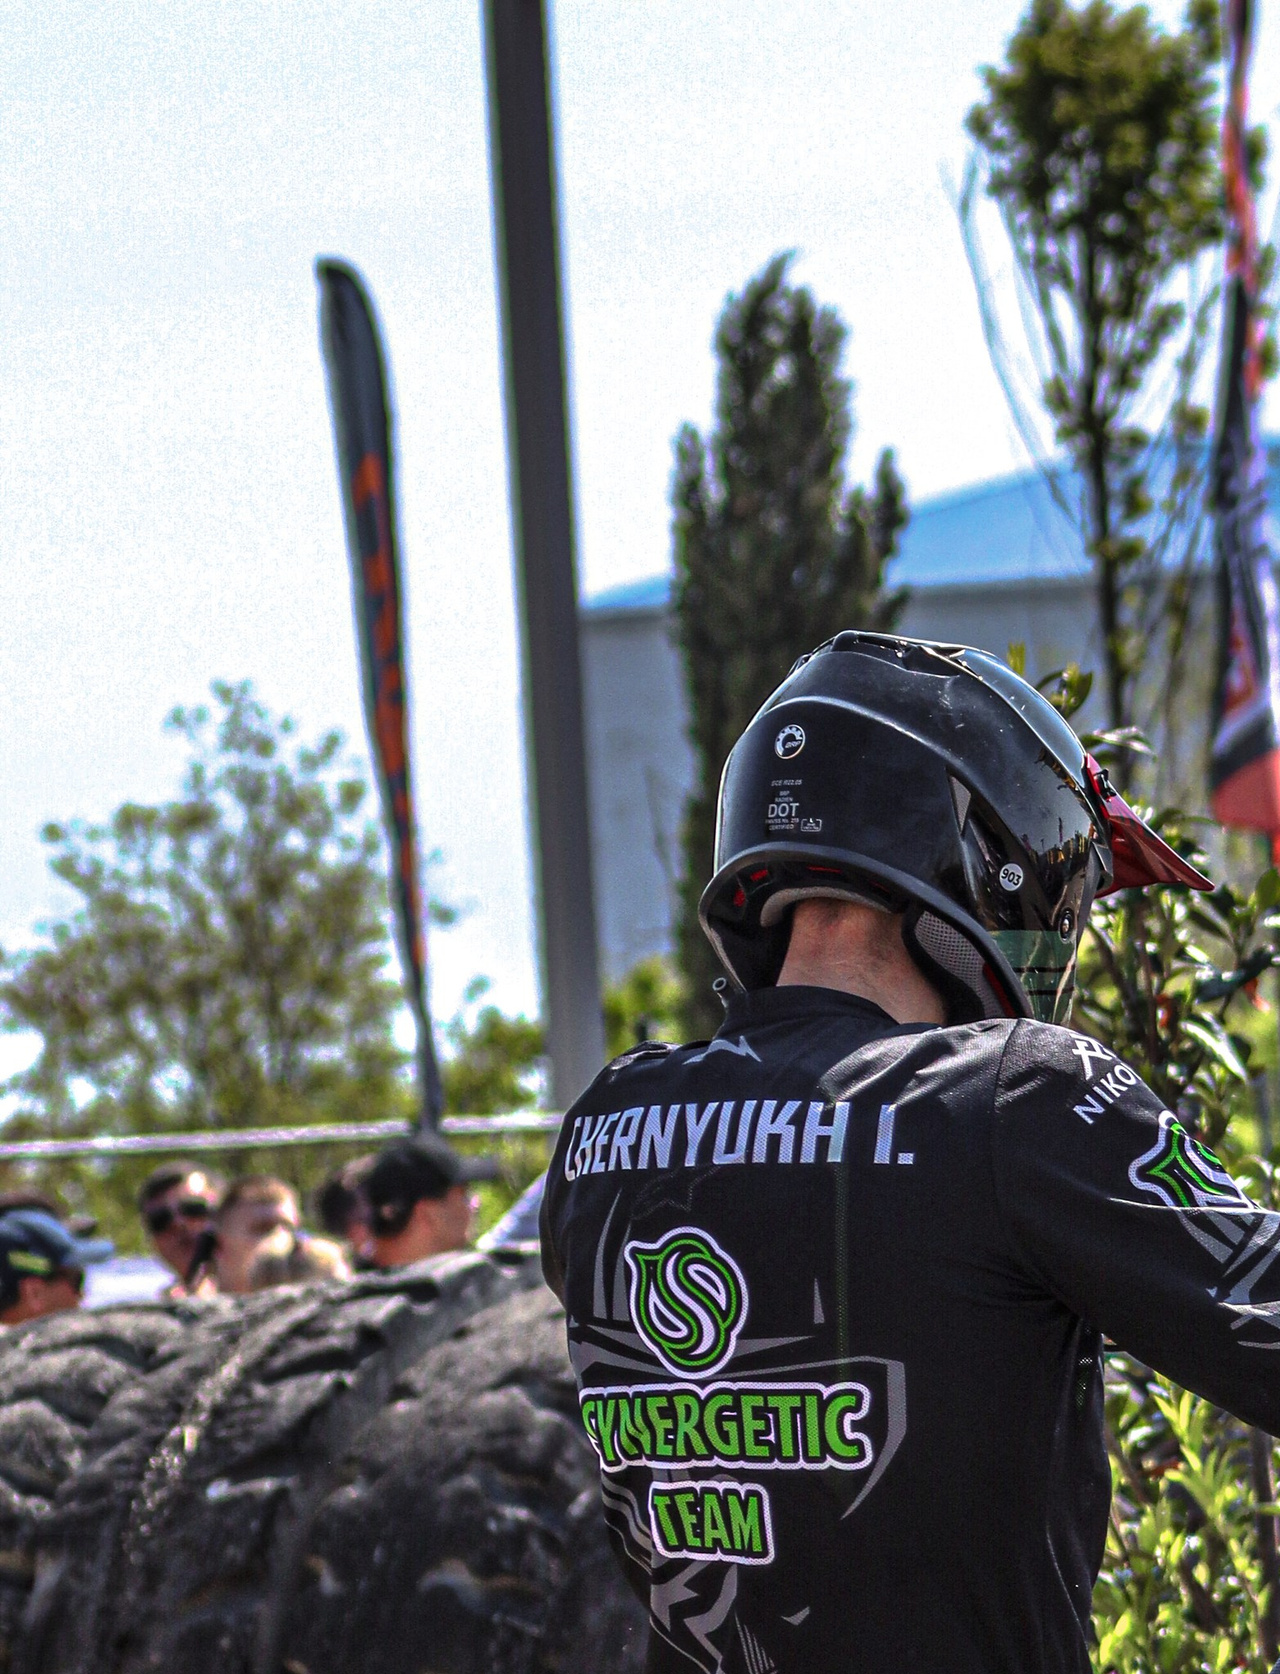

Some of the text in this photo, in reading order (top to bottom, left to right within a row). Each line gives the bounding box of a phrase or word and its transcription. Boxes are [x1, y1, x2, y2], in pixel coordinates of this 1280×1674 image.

[768, 803, 799, 818] DOT
[1001, 868, 1022, 886] 903
[1073, 1062, 1142, 1125] NIKO
[564, 1099, 851, 1182] CHERNYUKH
[581, 1393, 861, 1463] SYNERGETIC
[653, 1493, 763, 1553] TEAM
